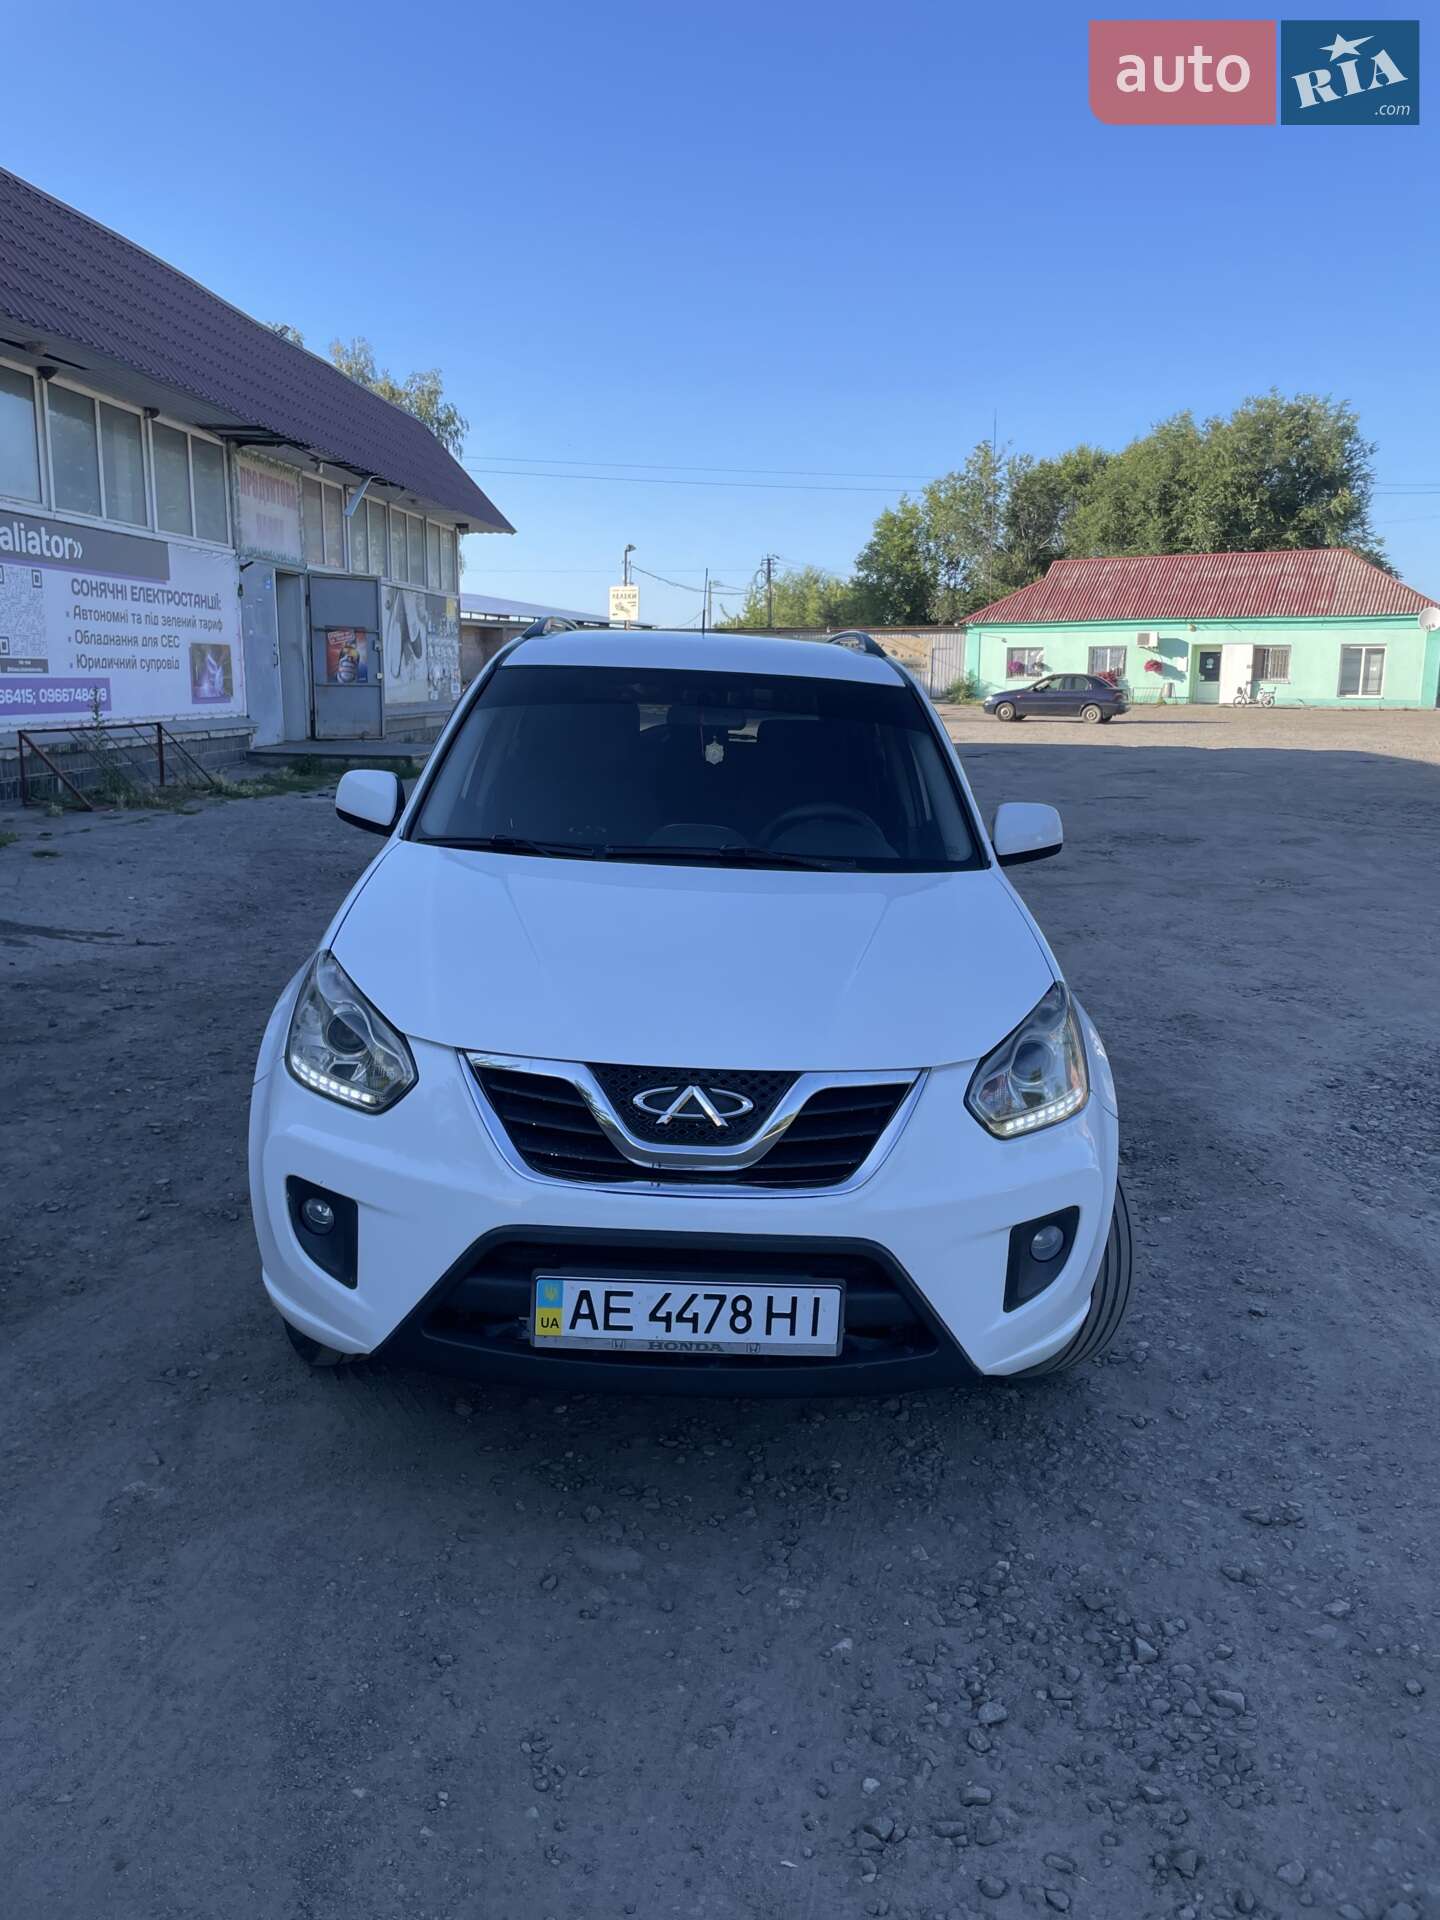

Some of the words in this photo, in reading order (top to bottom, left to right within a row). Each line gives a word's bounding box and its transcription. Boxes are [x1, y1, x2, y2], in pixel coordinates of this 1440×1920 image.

[71, 578, 128, 601] СОНЯЧНІ
[73, 605, 129, 623] Автономні
[131, 612, 142, 625] та
[145, 612, 159, 627] під
[161, 615, 197, 630] зелений
[198, 618, 223, 633] тариф
[74, 629, 139, 647] Обладнання
[141, 635, 158, 649] для
[160, 634, 181, 649] СЕС
[76, 653, 138, 672] Юридичний
[140, 656, 181, 673] супровід
[540, 1317, 560, 1329] UA
[569, 1289, 634, 1332] AE
[648, 1292, 753, 1335] 4478
[764, 1295, 821, 1337] HI
[647, 1340, 725, 1353] HONDA
